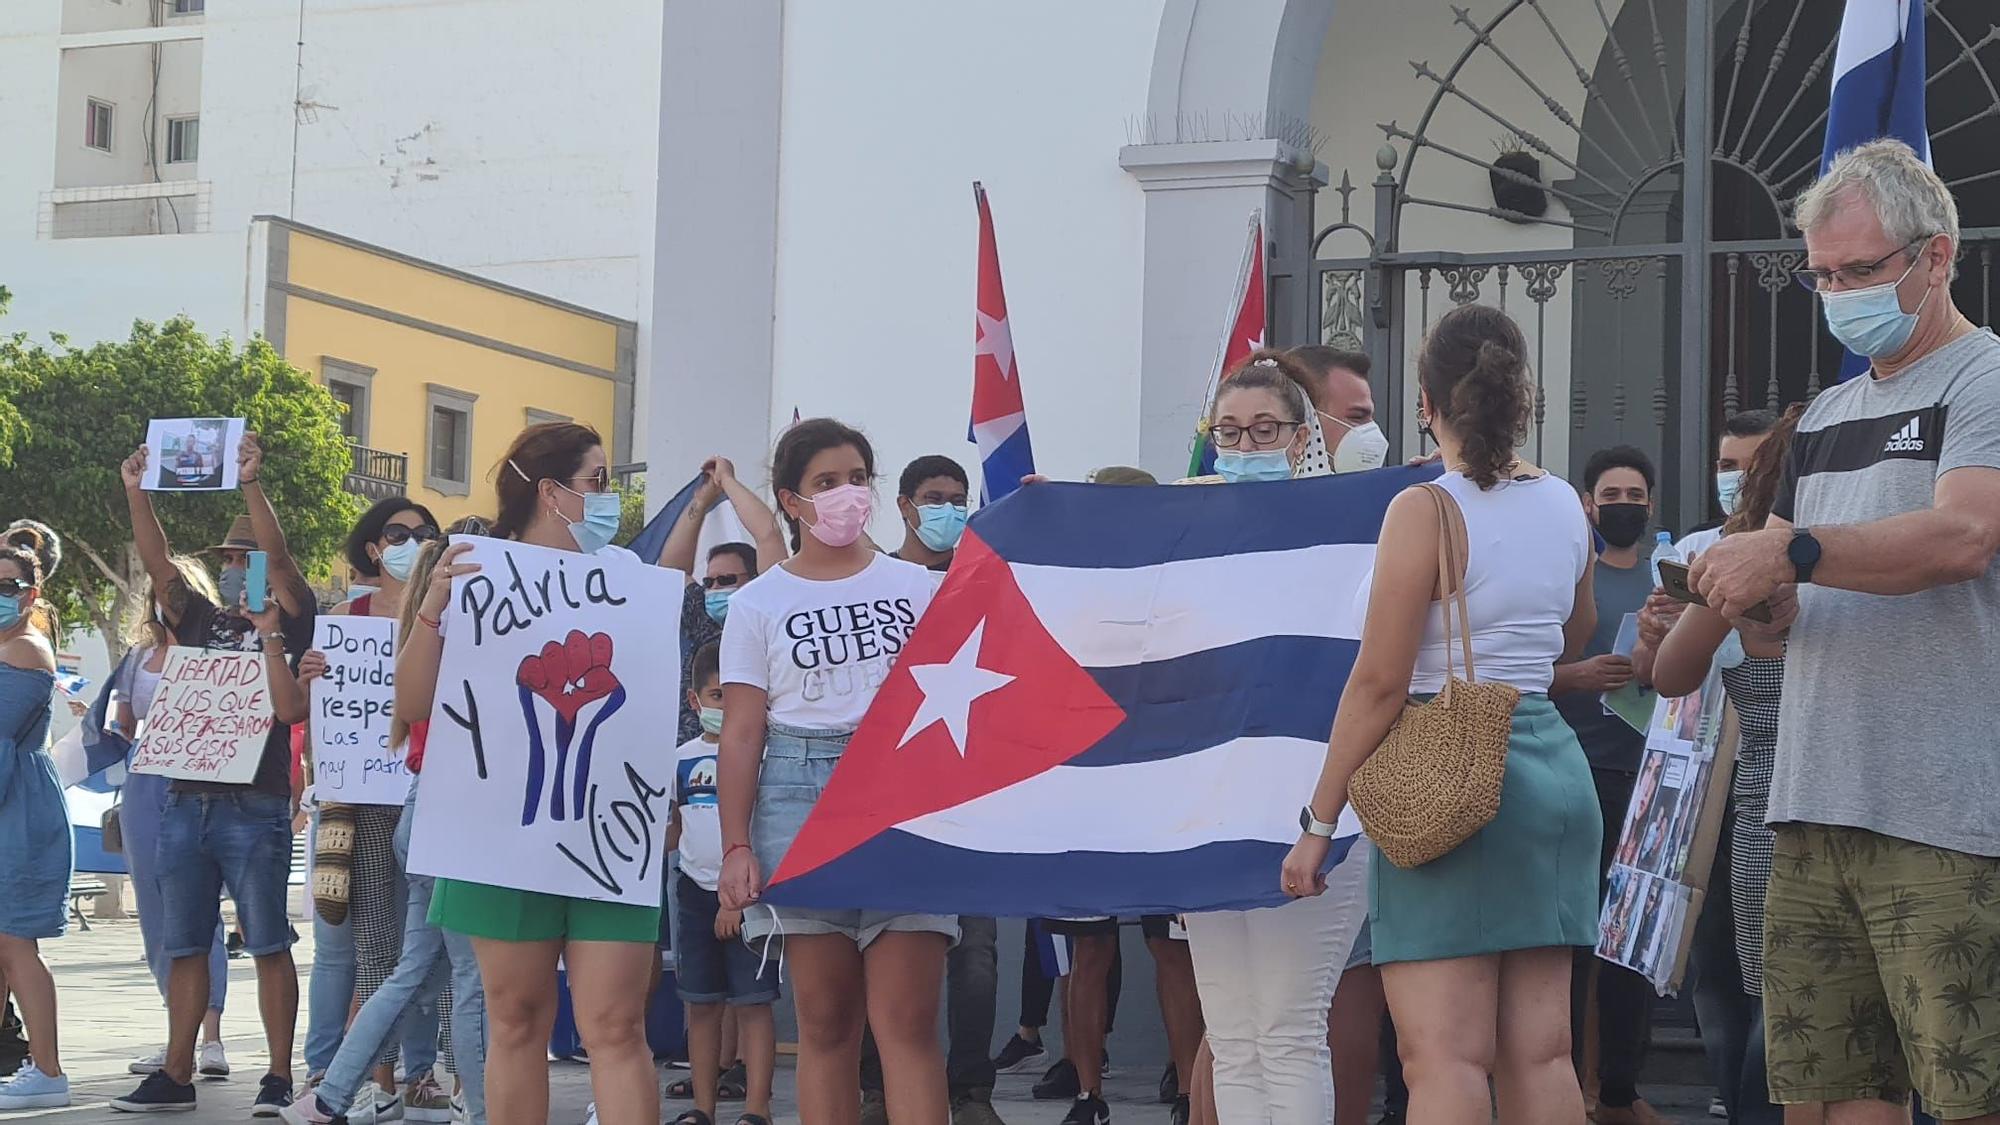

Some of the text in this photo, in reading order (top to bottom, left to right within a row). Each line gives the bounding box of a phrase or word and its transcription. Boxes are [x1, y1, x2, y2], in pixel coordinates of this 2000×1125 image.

[1884, 437, 1924, 452] adidas
[460, 550, 627, 646] Patria
[785, 598, 916, 640] GUESS
[150, 685, 169, 713] A
[173, 684, 212, 714] LOS
[142, 710, 175, 735] NO
[134, 734, 239, 759] A SUS CASAS
